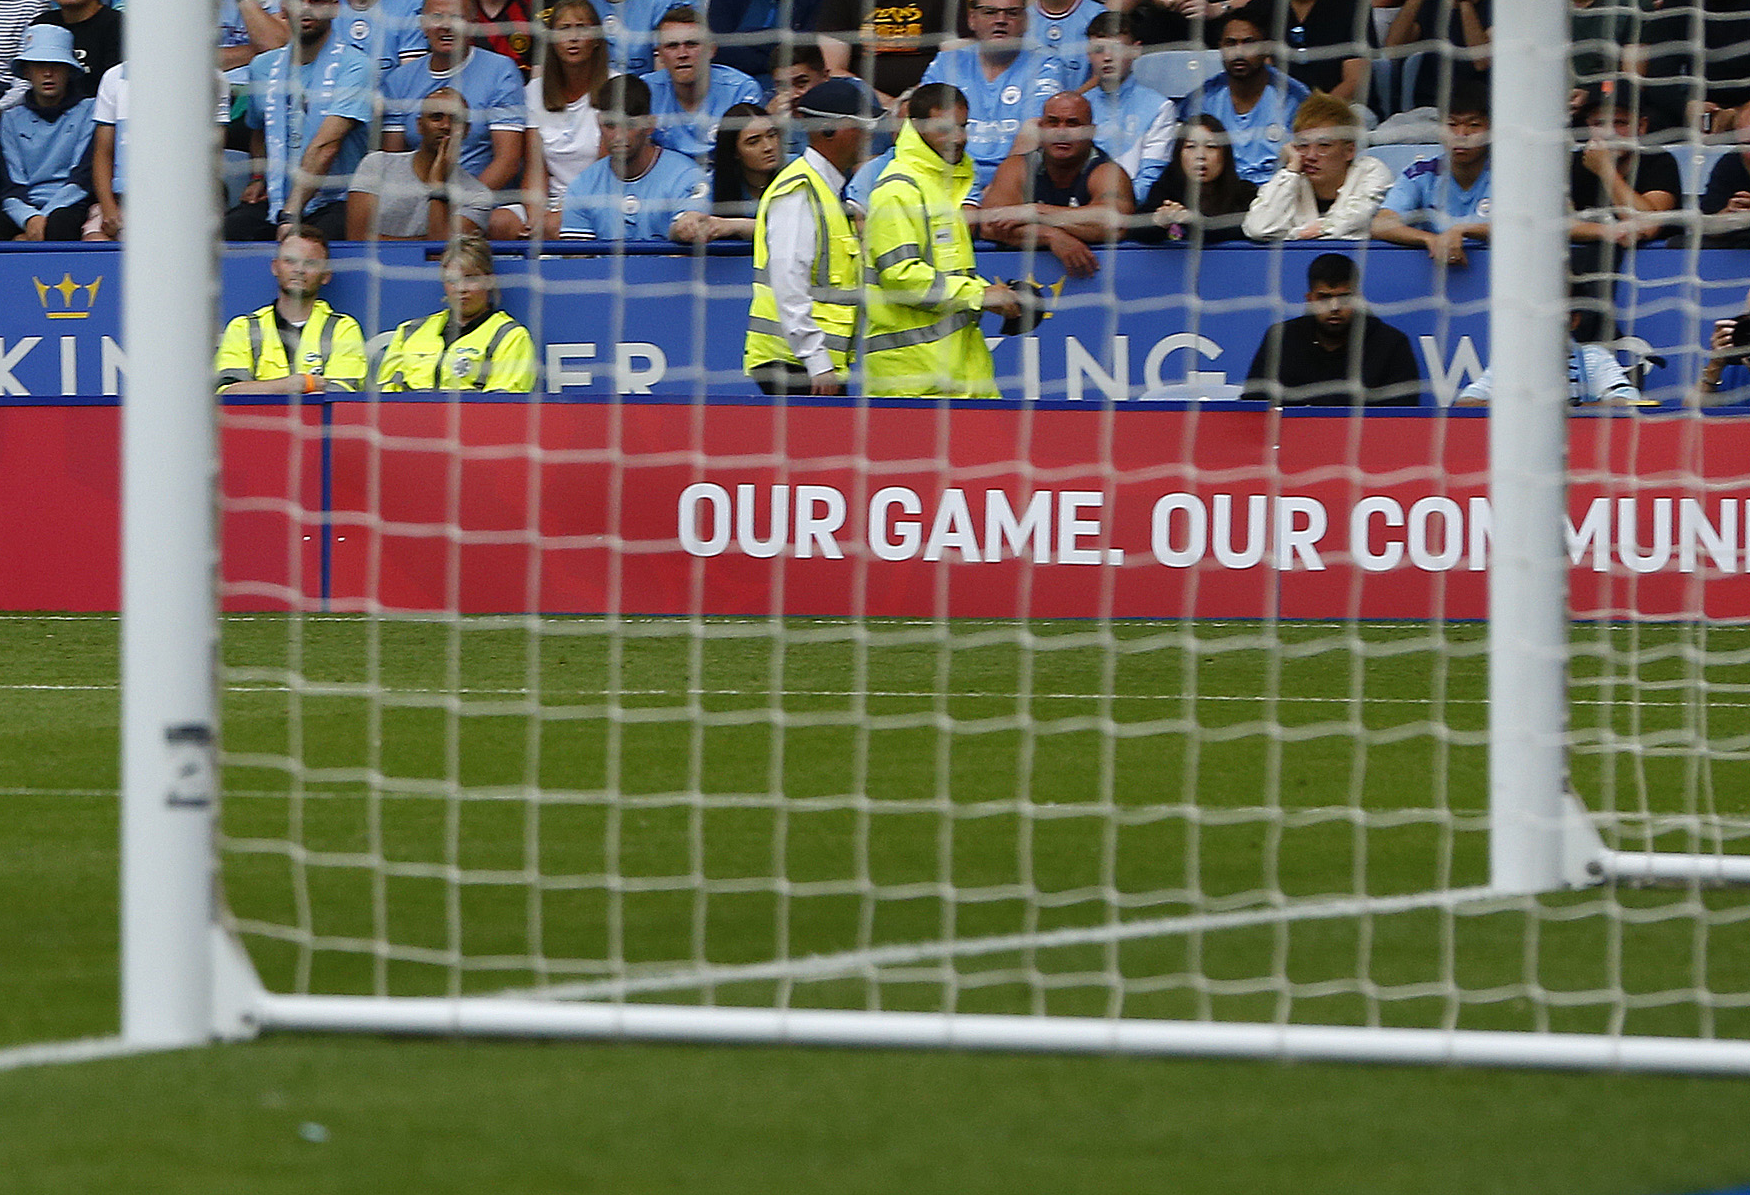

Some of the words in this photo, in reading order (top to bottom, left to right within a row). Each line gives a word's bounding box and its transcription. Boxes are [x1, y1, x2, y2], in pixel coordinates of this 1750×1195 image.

[985, 332, 1227, 401] ING
[677, 482, 846, 560] OUR
[868, 486, 1124, 566] GAME.
[1151, 491, 1327, 572] OUR
[1350, 496, 1750, 573] COMUN
